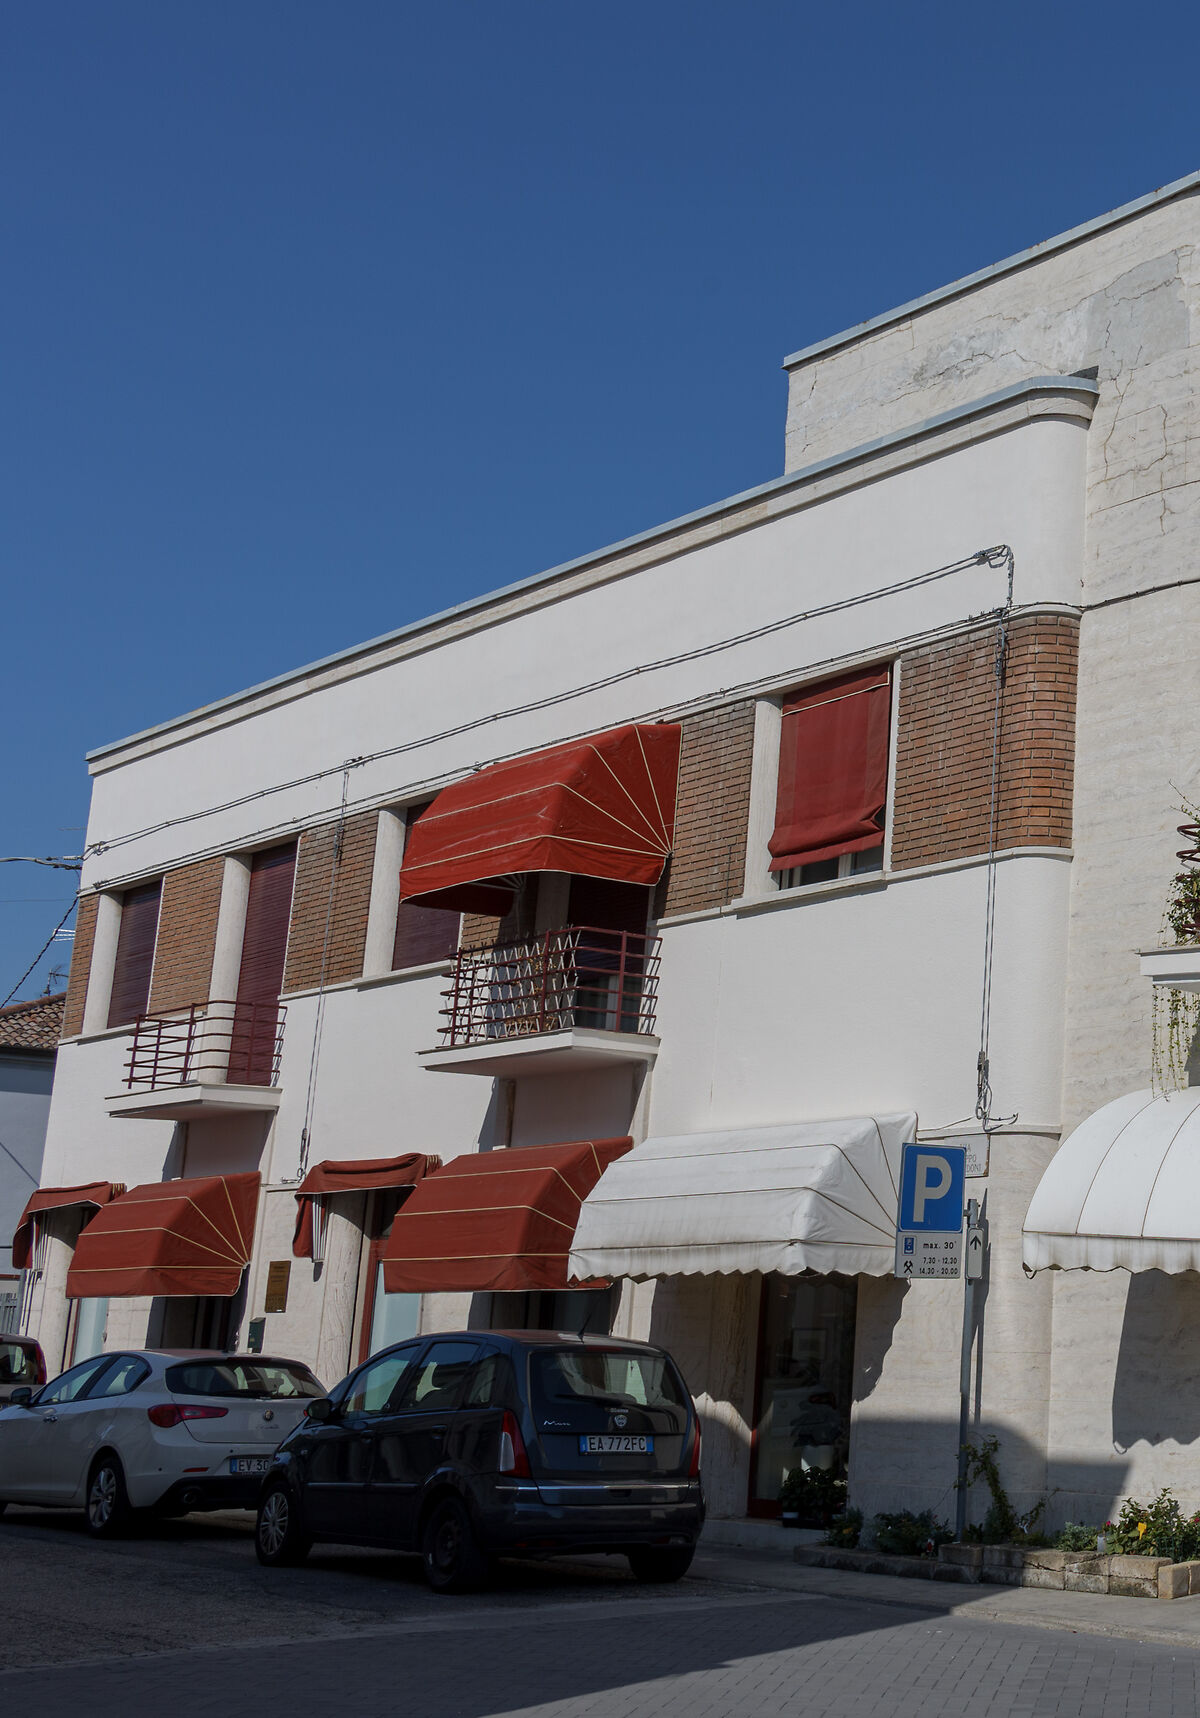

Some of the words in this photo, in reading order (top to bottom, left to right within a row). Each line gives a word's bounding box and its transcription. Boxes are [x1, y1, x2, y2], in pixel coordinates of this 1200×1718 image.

[913, 1154, 952, 1222] P
[588, 1437, 604, 1451] EA
[238, 1459, 252, 1472] EV
